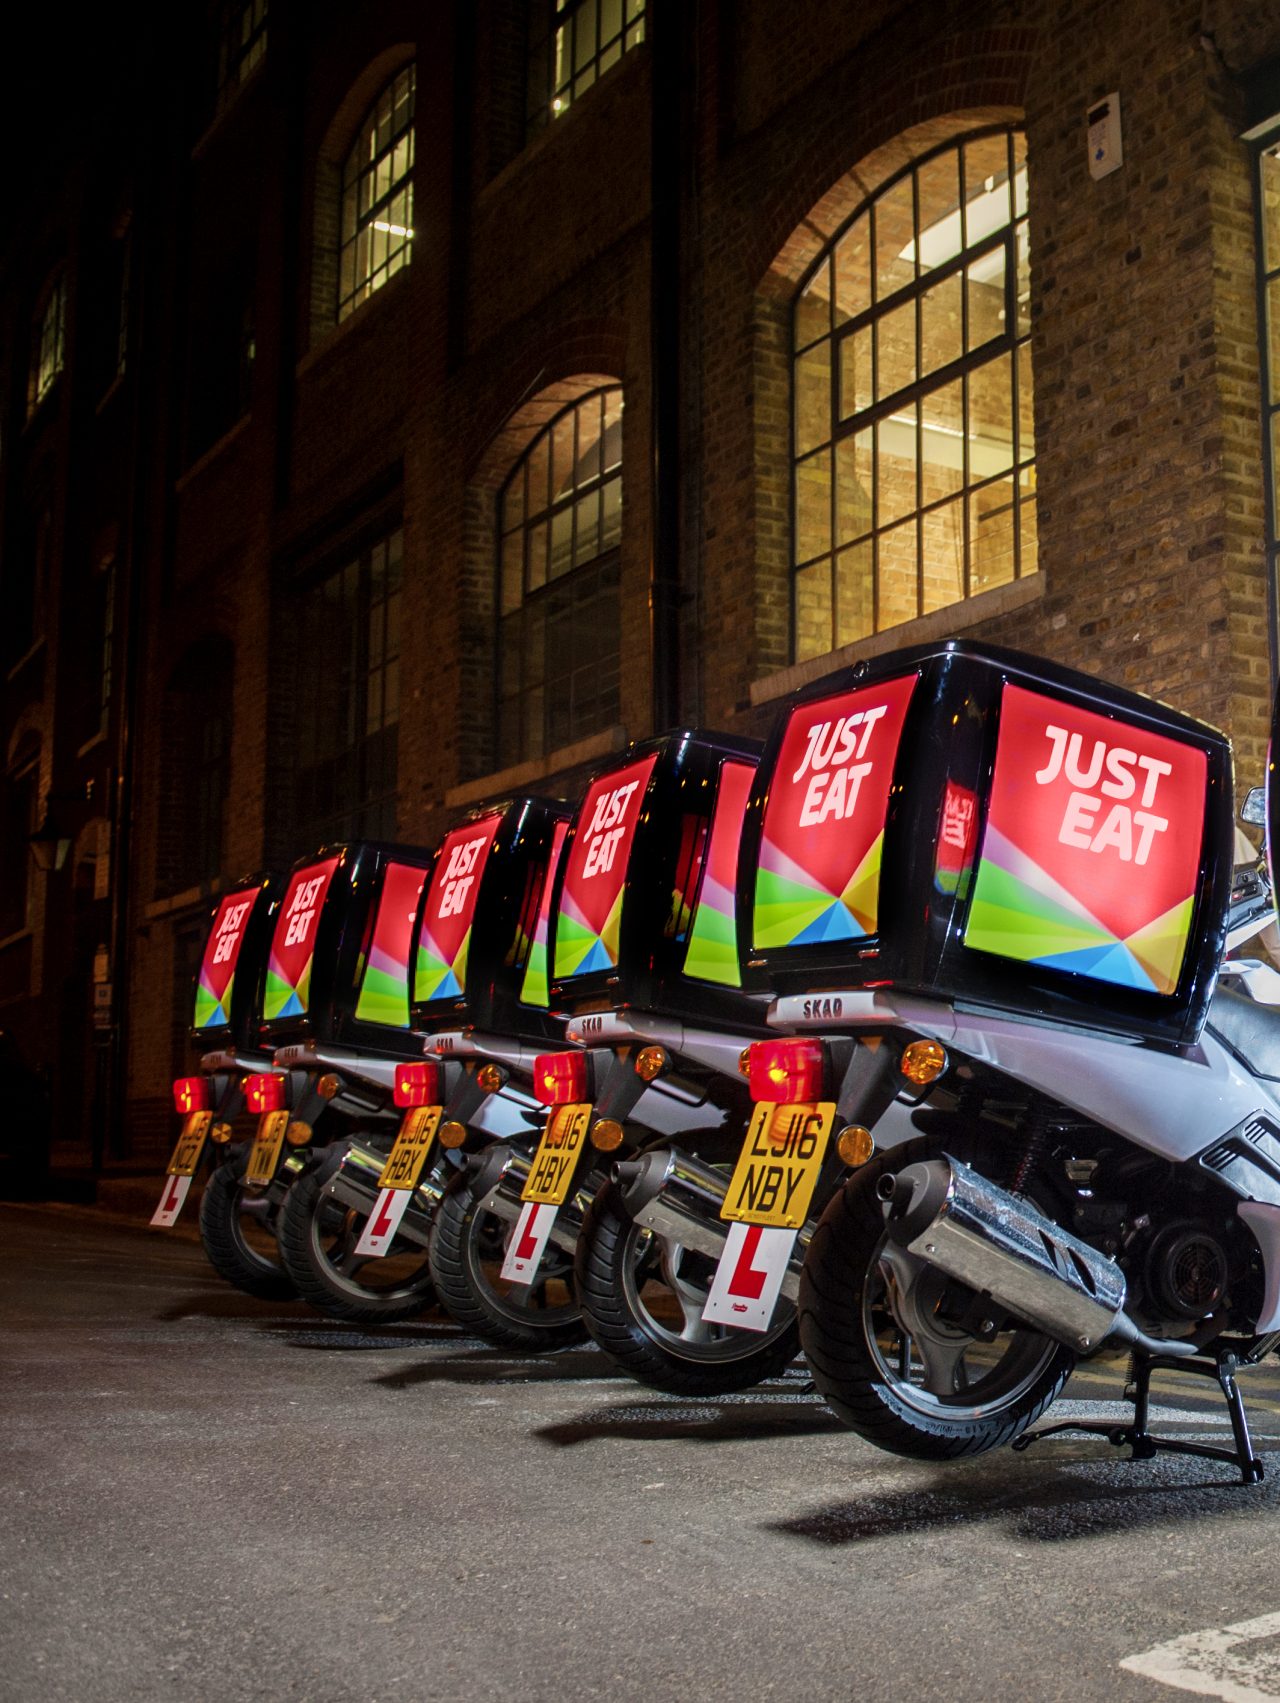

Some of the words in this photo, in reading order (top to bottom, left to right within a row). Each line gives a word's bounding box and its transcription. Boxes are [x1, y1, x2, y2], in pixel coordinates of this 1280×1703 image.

[793, 705, 888, 784] JUST
[1035, 725, 1173, 808] JUST
[583, 780, 640, 843] JUST
[799, 762, 873, 827] EAT
[582, 826, 626, 879] EAT
[1058, 791, 1169, 866] EAT
[440, 836, 487, 887] JUST
[216, 902, 250, 939] JUST
[286, 875, 326, 919] JUST
[438, 875, 474, 919] EAT
[212, 932, 240, 964] EAT
[284, 909, 316, 947] EAT
[803, 998, 843, 1019] SKAD
[400, 1113, 435, 1145] LJ16
[544, 1113, 586, 1151] LJ16
[750, 1111, 823, 1160] LJ16
[386, 1149, 421, 1181] HBX
[530, 1156, 571, 1194] HBY
[163, 1176, 180, 1212] L
[370, 1189, 396, 1237] L
[736, 1164, 805, 1215] NBY
[515, 1203, 541, 1260] L
[727, 1225, 768, 1300] L
